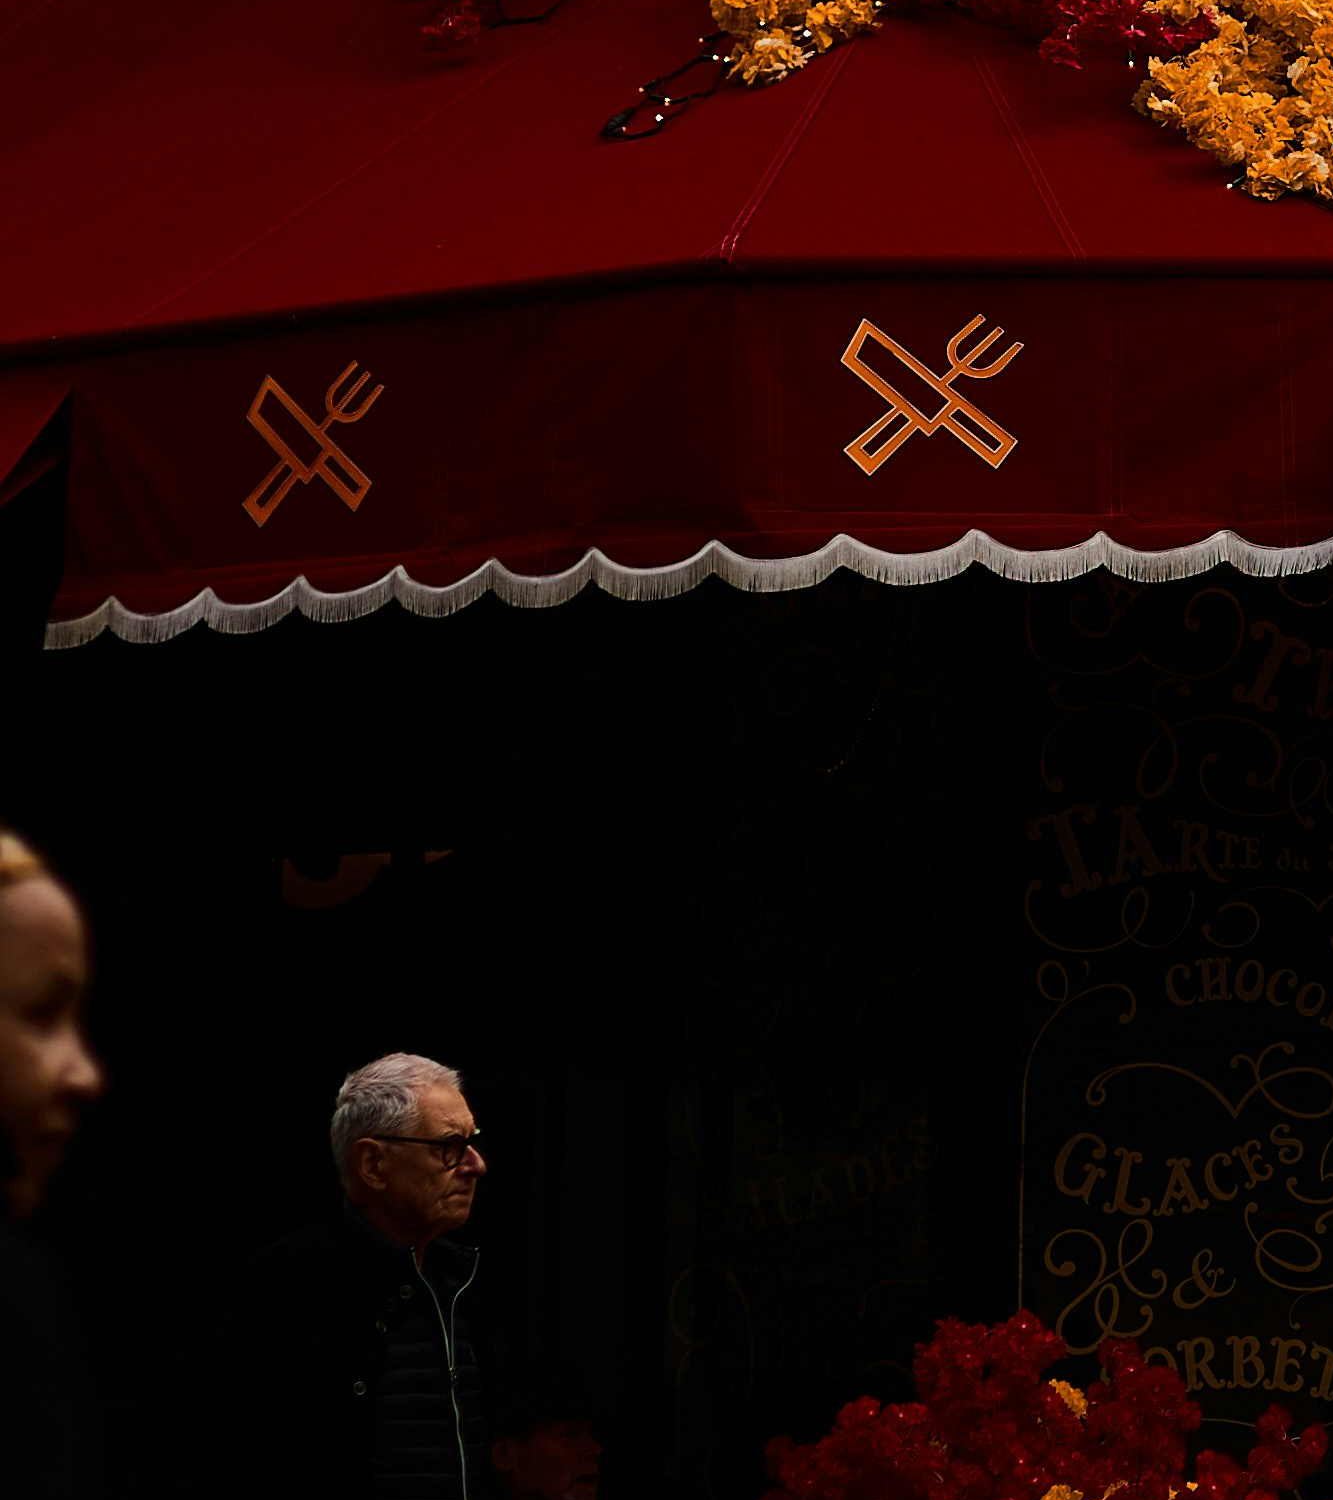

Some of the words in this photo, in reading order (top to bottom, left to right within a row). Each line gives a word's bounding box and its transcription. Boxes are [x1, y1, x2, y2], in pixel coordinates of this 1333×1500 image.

[1025, 801, 1263, 898] TARTE
[1275, 848, 1312, 873] du
[1053, 1122, 1304, 1217] GLACES
[1172, 1248, 1237, 1310] &
